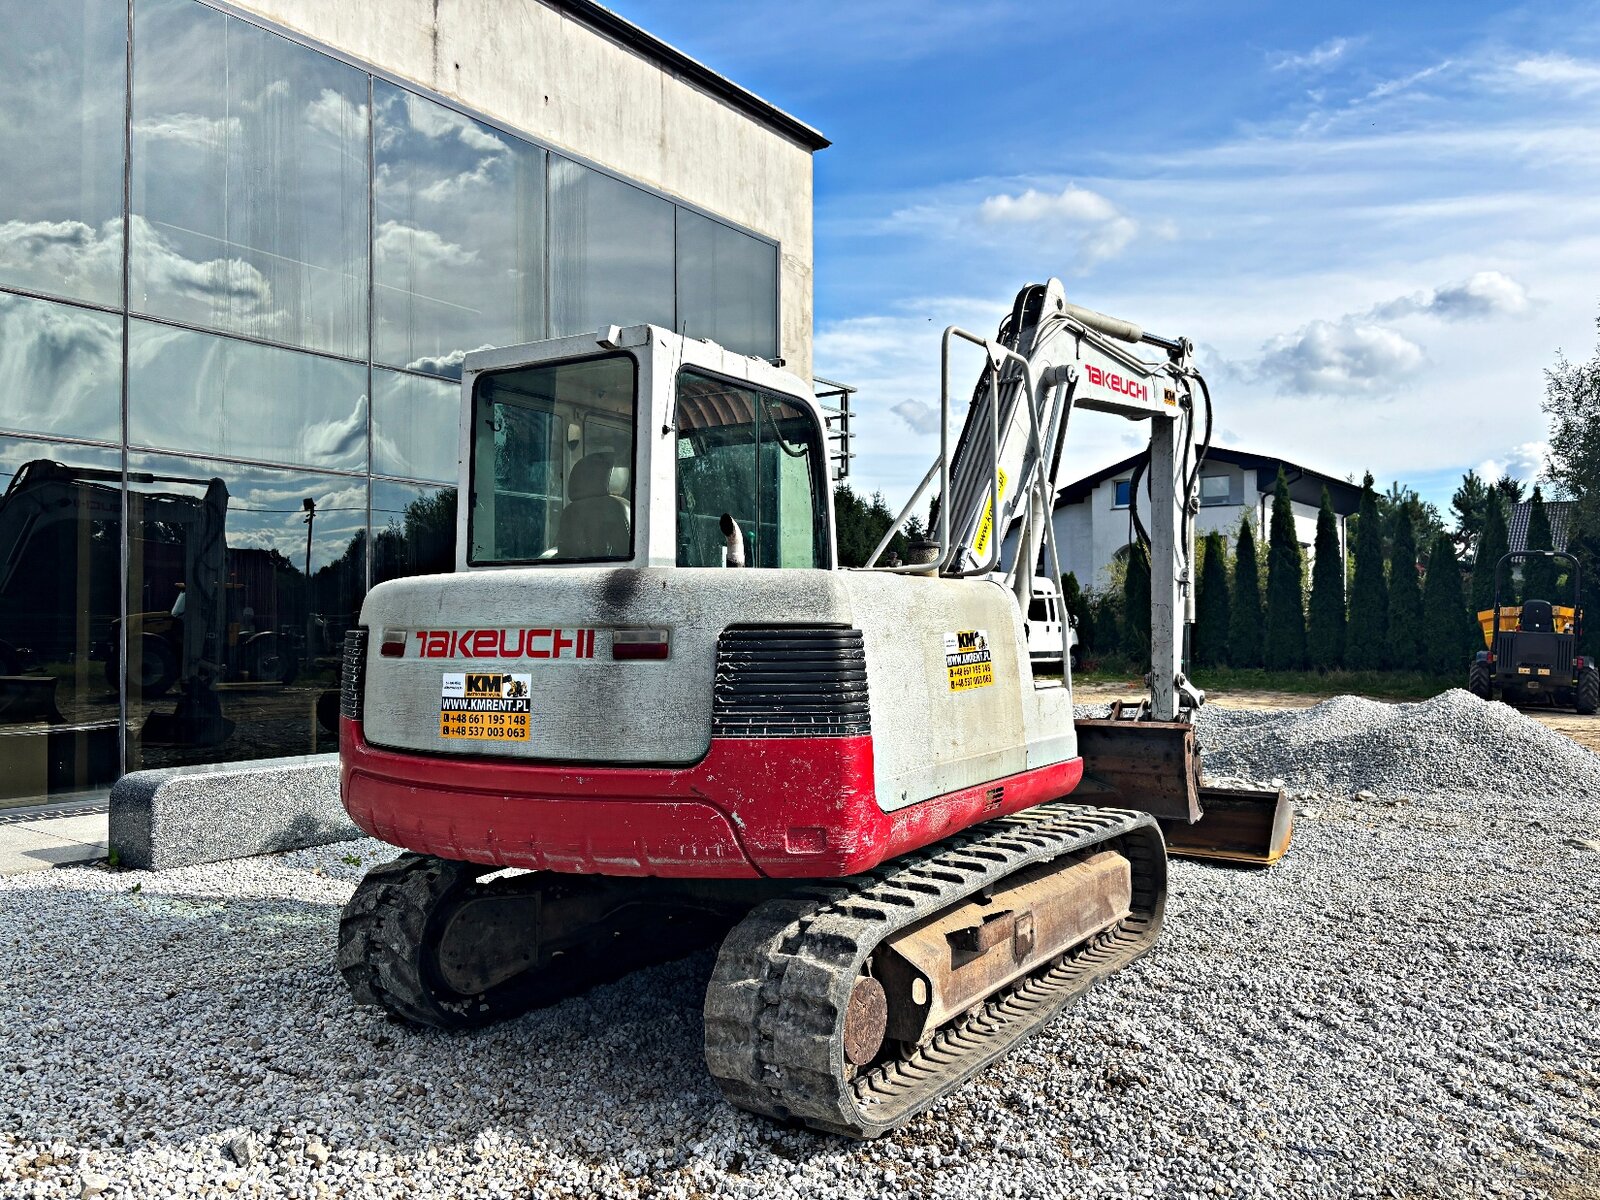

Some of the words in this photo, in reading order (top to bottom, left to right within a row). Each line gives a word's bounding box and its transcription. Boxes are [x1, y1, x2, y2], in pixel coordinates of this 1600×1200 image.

[1085, 364, 1148, 402] TAKEUCHI
[415, 629, 595, 659] TAKEUCHI
[957, 632, 976, 648] KM
[946, 651, 991, 666] WWW.KMRENT.PL
[467, 675, 502, 692] KM
[442, 698, 529, 712] WWW.KMRENT.PL
[451, 714, 467, 724] +48
[468, 714, 484, 724] 661
[488, 714, 505, 725] 195
[508, 715, 526, 726] 148
[451, 726, 466, 736] +48
[468, 726, 485, 737] 537
[487, 727, 505, 737] 003
[507, 727, 526, 738] 063
